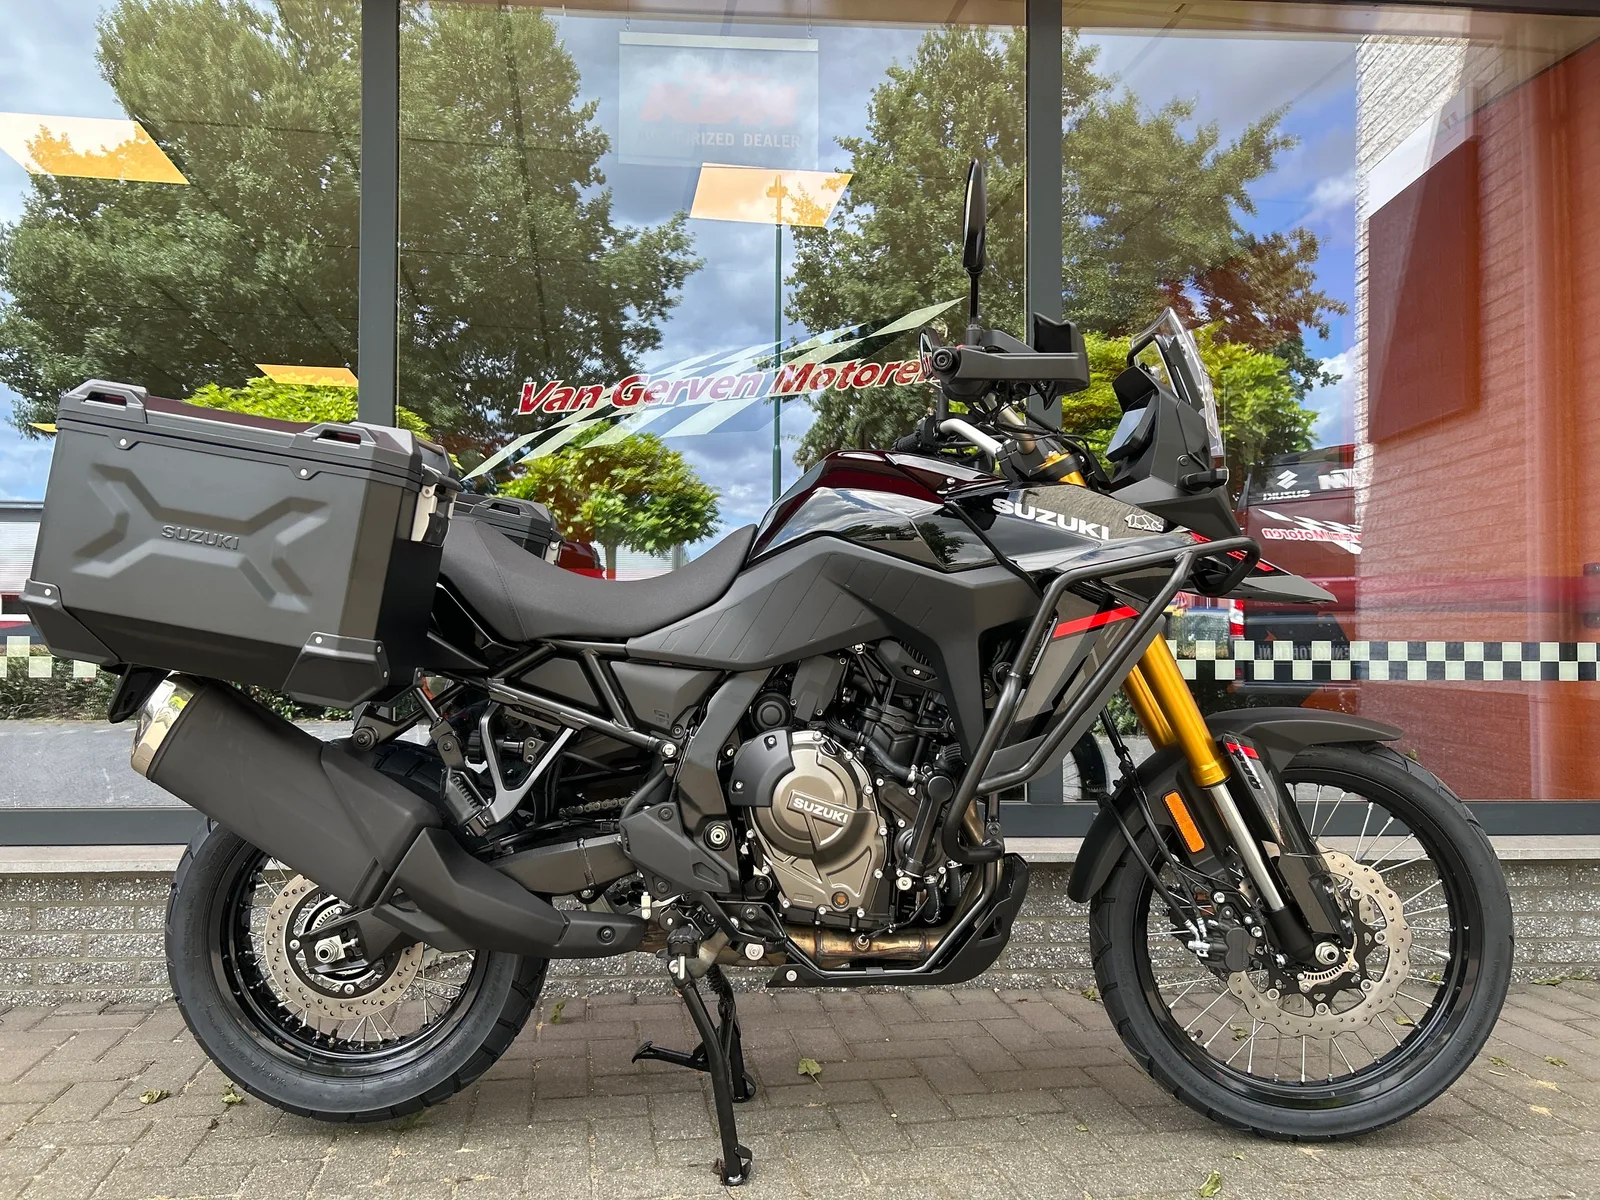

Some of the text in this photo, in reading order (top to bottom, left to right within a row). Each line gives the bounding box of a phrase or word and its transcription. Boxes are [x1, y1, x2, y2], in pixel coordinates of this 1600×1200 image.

[743, 132, 802, 148] DEALER
[518, 381, 605, 415] Van
[609, 372, 768, 407] Gerven
[992, 497, 1110, 541] SUZUKI
[161, 524, 240, 550] SUZUKI
[793, 797, 849, 824] SUZUKI
